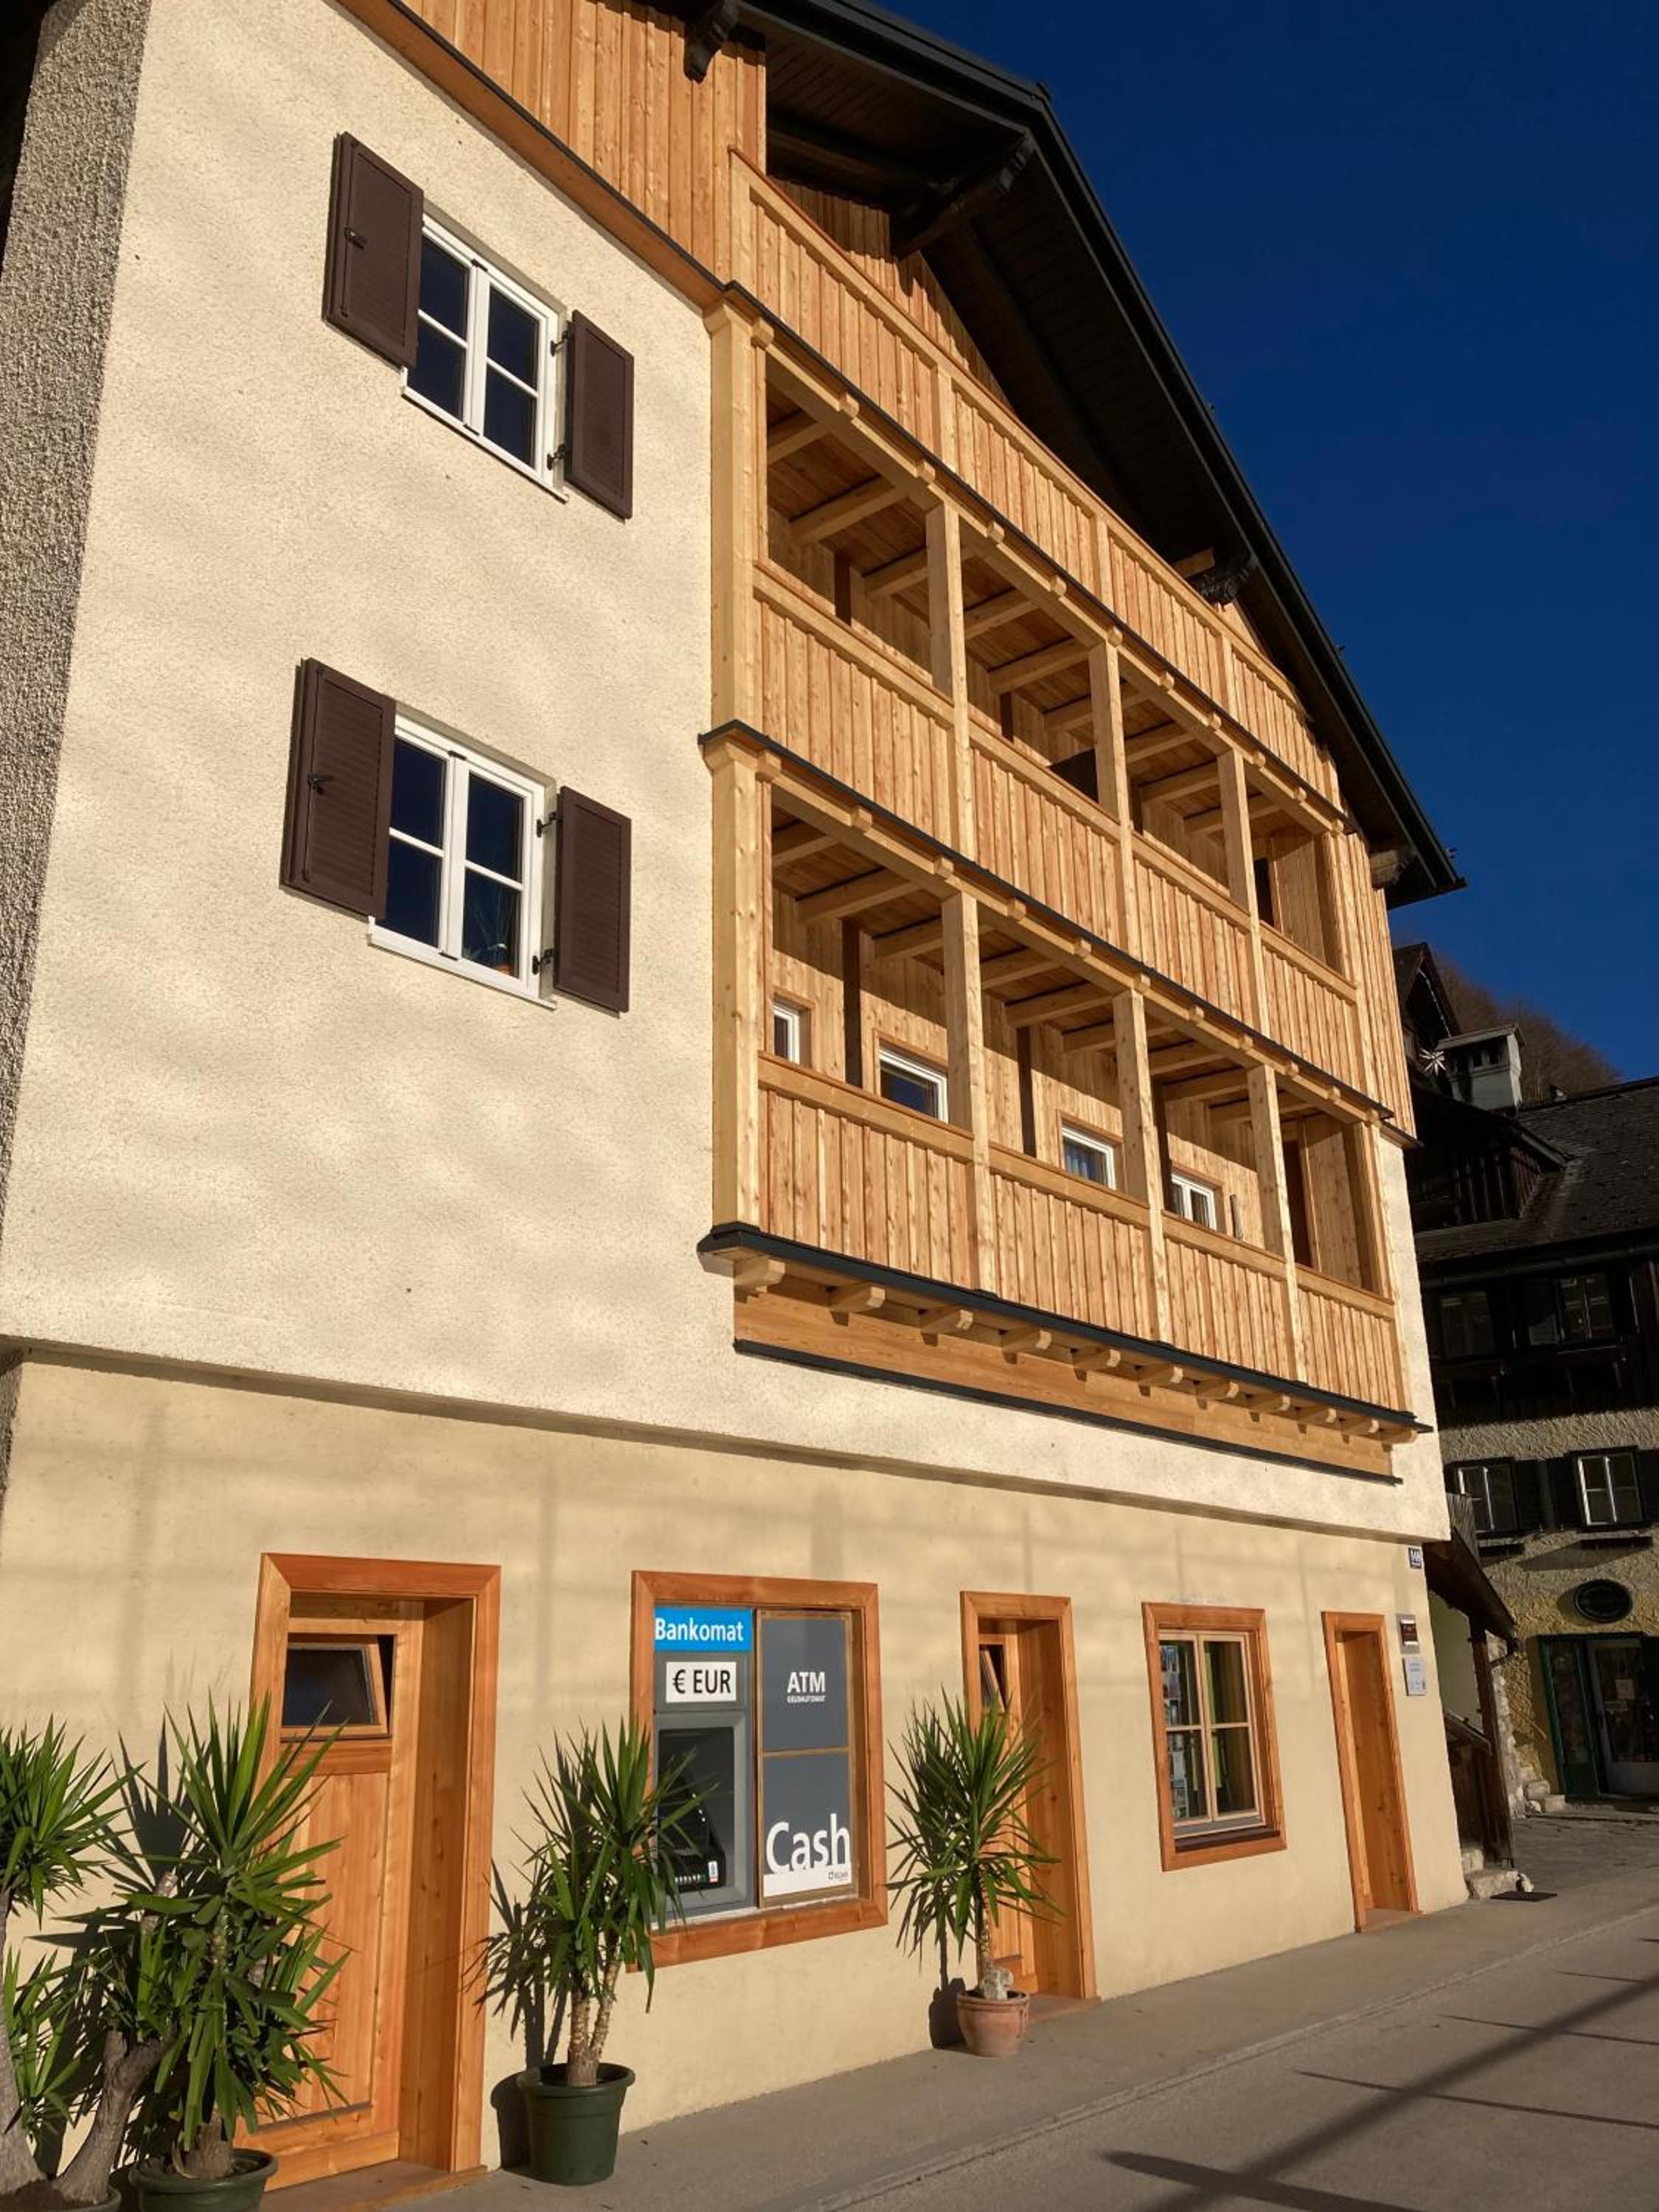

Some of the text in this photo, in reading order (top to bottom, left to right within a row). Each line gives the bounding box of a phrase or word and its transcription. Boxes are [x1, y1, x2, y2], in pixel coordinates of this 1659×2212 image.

[655, 1617, 743, 1641] Bankomat
[693, 1669, 731, 1694] EUR
[787, 1672, 825, 1693] ATM
[766, 1813, 850, 1874] Cash
